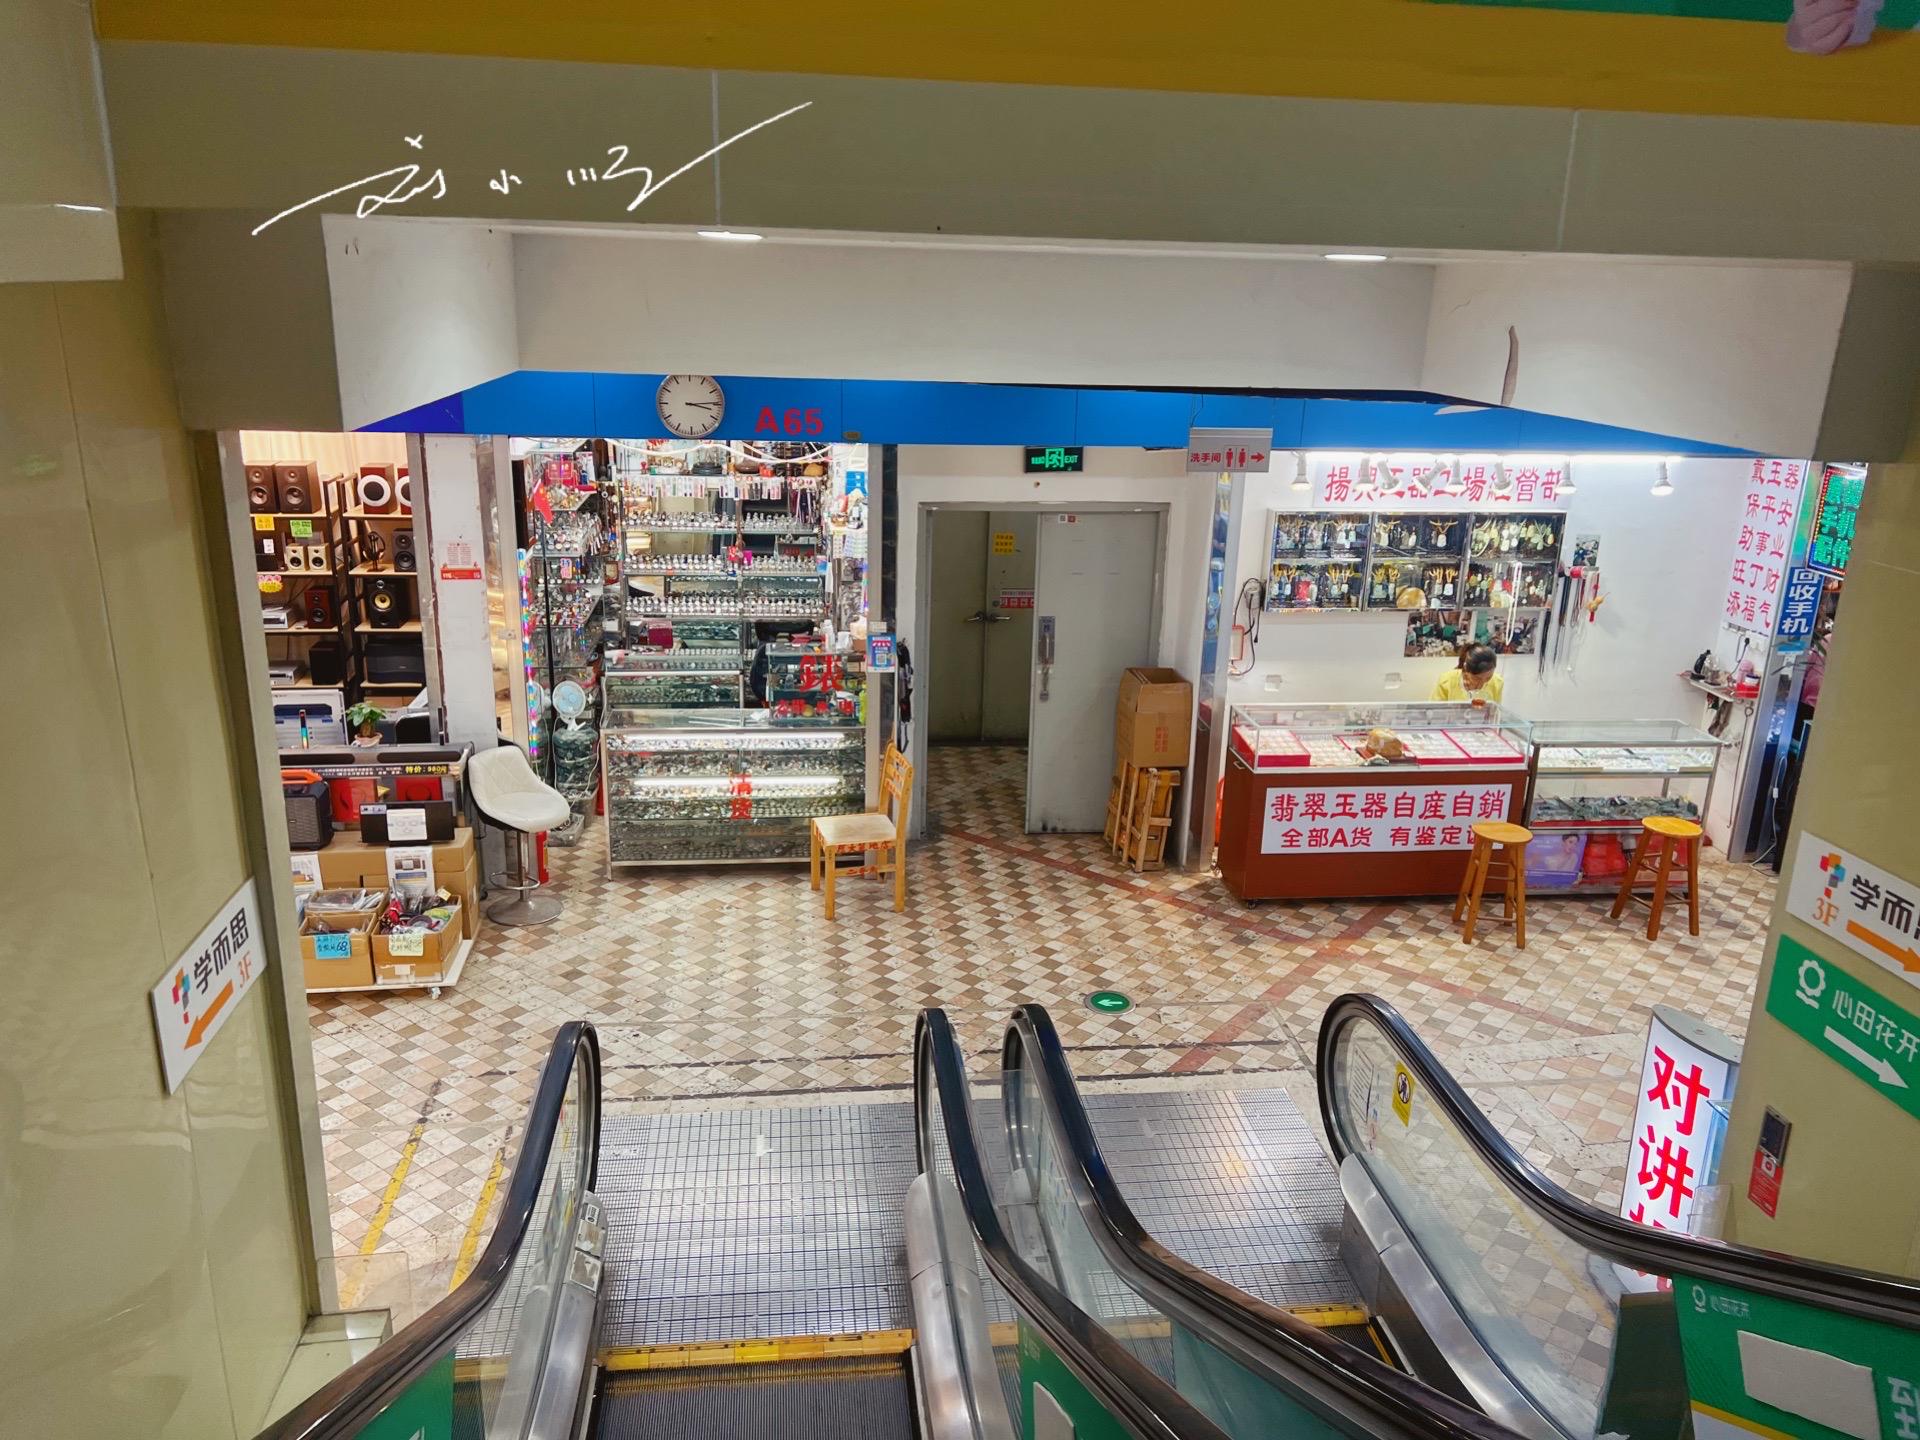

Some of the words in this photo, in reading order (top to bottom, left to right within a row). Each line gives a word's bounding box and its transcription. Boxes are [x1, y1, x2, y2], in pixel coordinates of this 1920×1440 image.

[755, 407, 824, 435] A65
[1190, 452, 1221, 463] 洗手间
[1746, 492, 1792, 528] 保平安
[1738, 525, 1784, 559] 助事业
[1732, 559, 1780, 594] 旺丁财
[1726, 591, 1772, 629] 添福气
[1781, 568, 1820, 634] 回收手机
[1280, 827, 1373, 848] 全部A货
[1812, 896, 1840, 927] 3F
[1850, 874, 1920, 940] 学而
[193, 907, 249, 995] 学而思
[237, 950, 253, 988] 3F
[1832, 989, 1920, 1063] 心田花开
